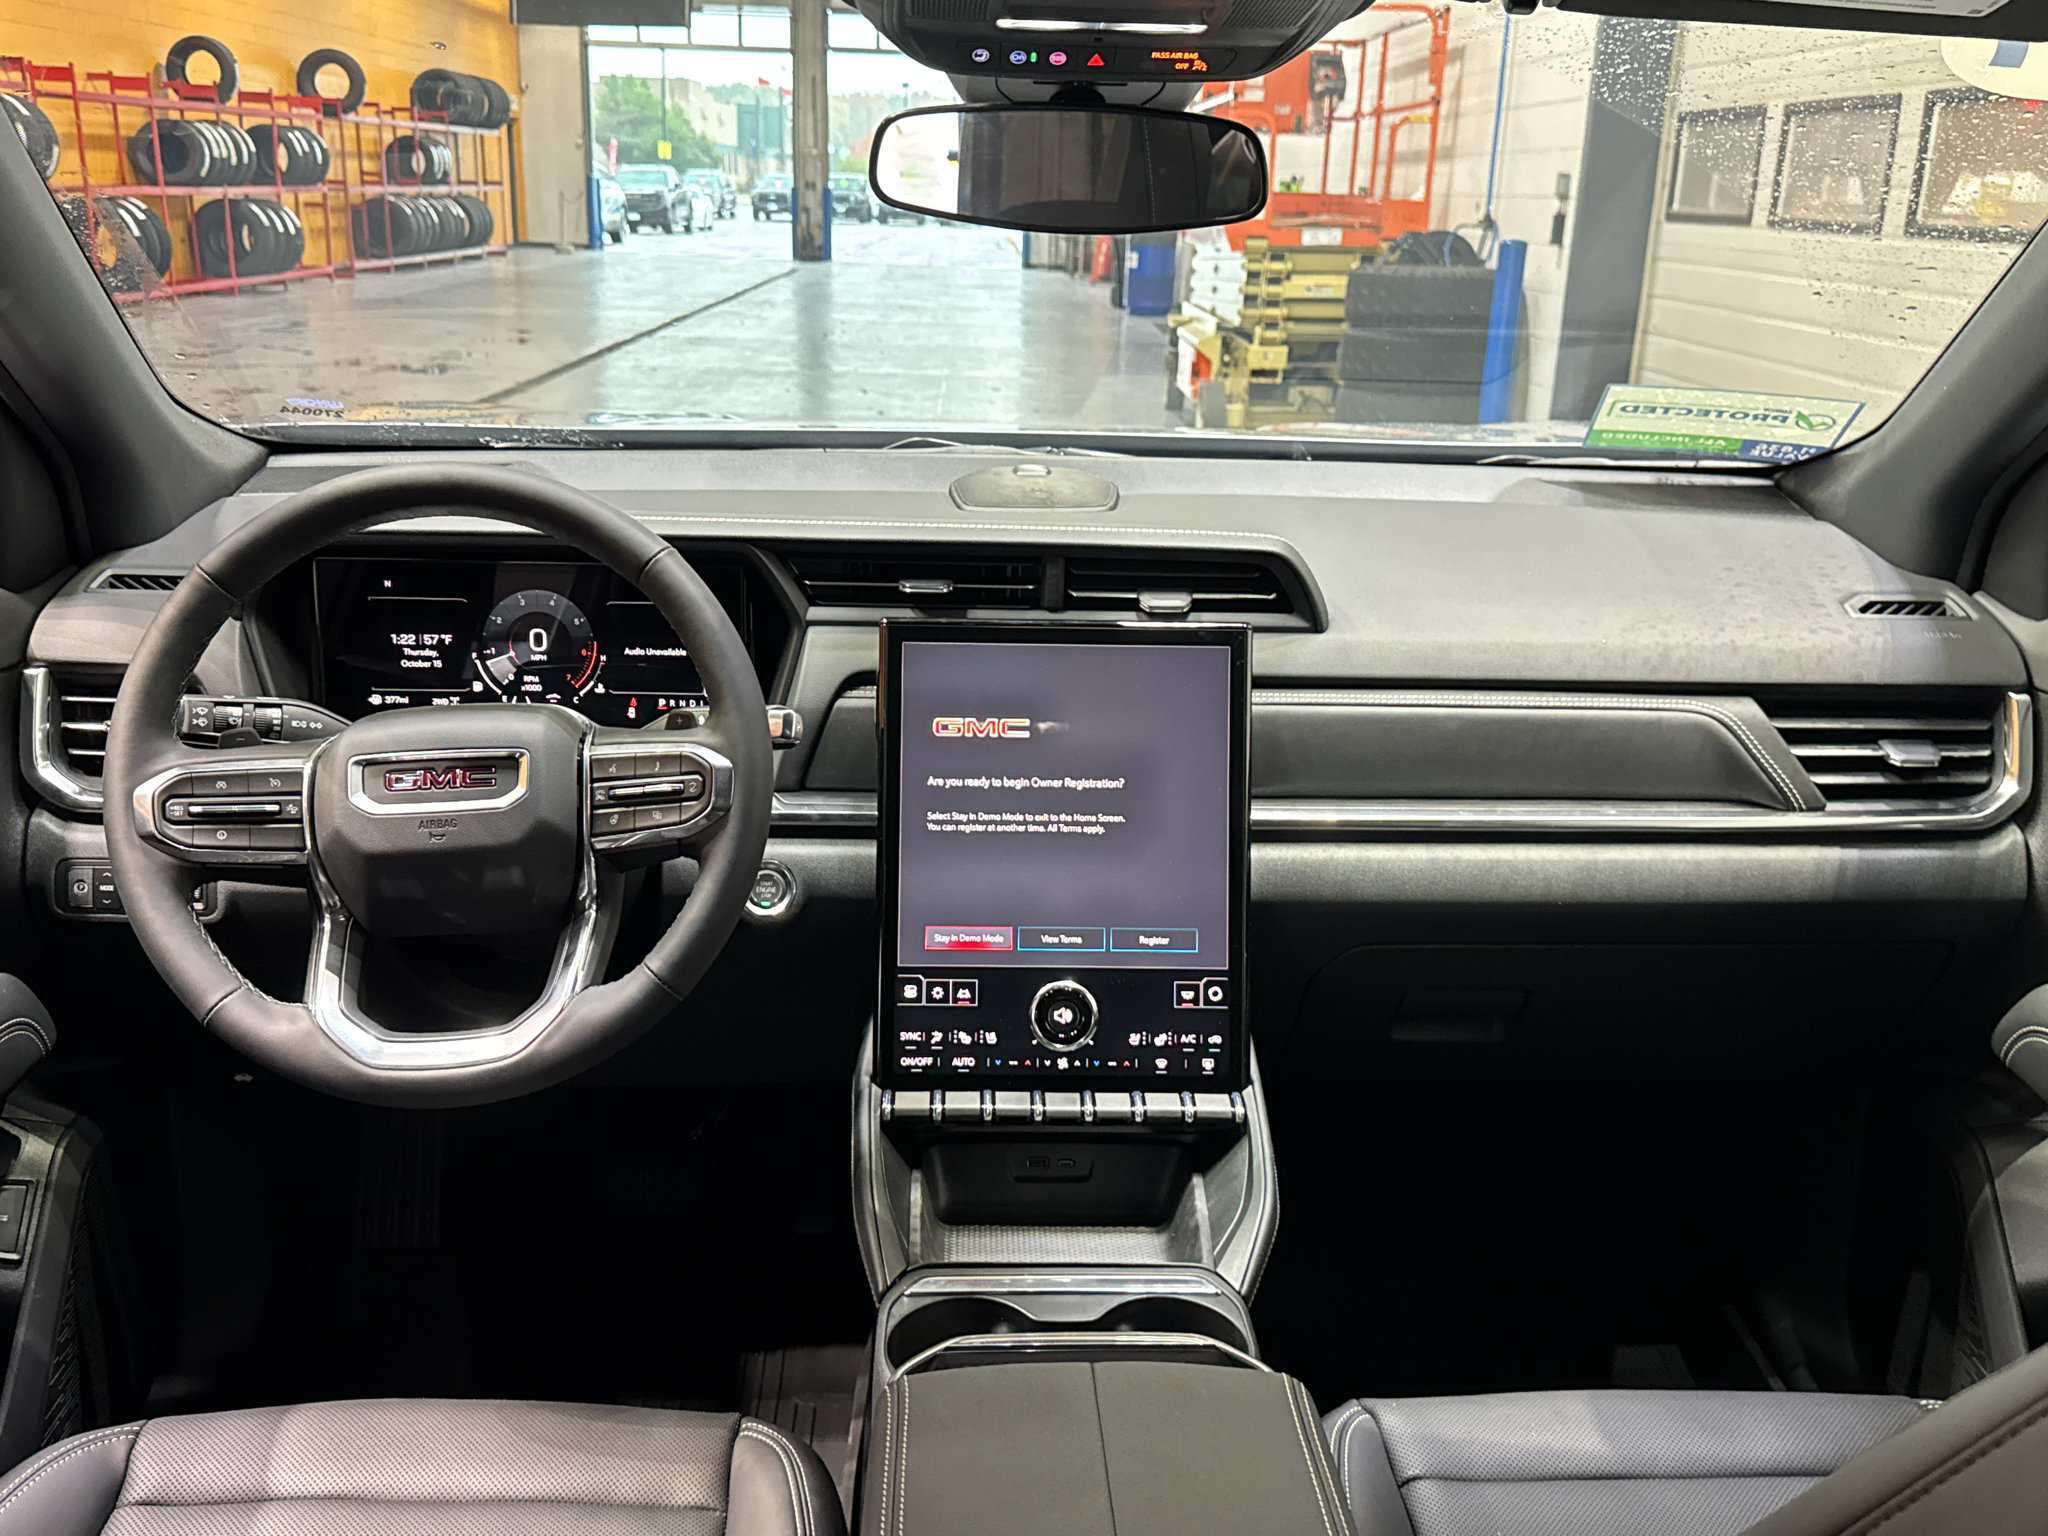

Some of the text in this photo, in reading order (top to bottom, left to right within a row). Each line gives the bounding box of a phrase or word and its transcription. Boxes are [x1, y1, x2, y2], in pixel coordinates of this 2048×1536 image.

[1151, 51, 1170, 59] PASS
[1175, 62, 1189, 70] OFF
[383, 579, 392, 588] N
[390, 633, 417, 645] 1:22
[529, 628, 548, 652] 0
[623, 647, 687, 656] Audio Unavailable
[400, 659, 443, 668] October 15
[523, 675, 540, 683] RPM
[931, 716, 1031, 738] GMC
[385, 765, 497, 791] GMC
[926, 775, 1125, 791] Are you ready to begin Owner Registration?
[926, 811, 951, 821] Select
[951, 811, 968, 823] Stay
[977, 811, 1001, 821] Demo
[1002, 812, 1024, 821] Mode
[1025, 813, 1034, 822] to
[1034, 813, 1049, 822] exit
[1050, 813, 1058, 822] to
[1059, 813, 1072, 822] the
[1073, 813, 1097, 822] Home
[1097, 813, 1126, 823] Screen.
[418, 818, 458, 831] AIRBAG
[926, 822, 1106, 835] You can register at another time. All Terms apply.
[934, 933, 950, 945] Stay
[959, 933, 982, 943] Demo
[982, 934, 1004, 943] Mode
[1041, 934, 1083, 944] View Terms
[1138, 935, 1170, 946] Register
[900, 1031, 922, 1042] SYNC
[1180, 1033, 1197, 1044] A/C
[900, 1056, 934, 1067] ON/OFF
[951, 1056, 976, 1067] AUTO
